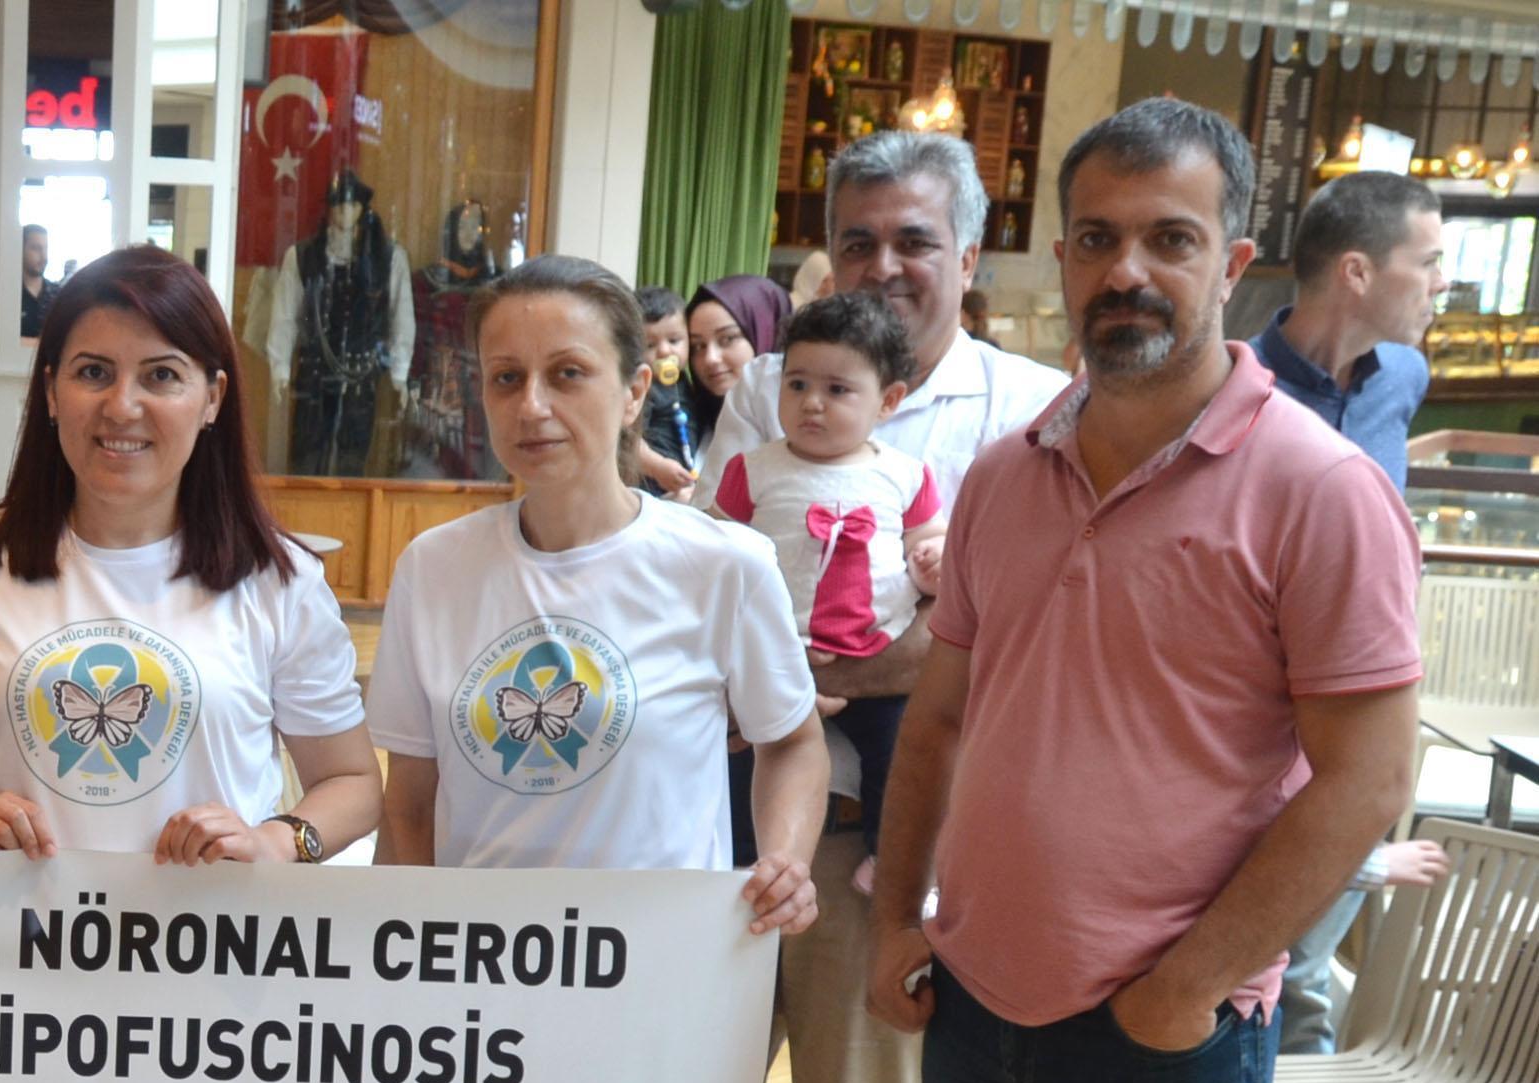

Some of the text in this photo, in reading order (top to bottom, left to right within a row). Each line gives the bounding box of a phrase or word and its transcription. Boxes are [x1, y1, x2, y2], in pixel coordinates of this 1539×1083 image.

[20, 724, 37, 751] NCL
[57, 626, 125, 646] MÜCADELE
[128, 629, 145, 642] VE
[462, 729, 481, 755] NCL
[565, 626, 581, 639] VE
[84, 785, 110, 796] 2018
[530, 776, 556, 787] 2018
[20, 892, 350, 978] NÖRONAL
[374, 908, 626, 988] CEROİD
